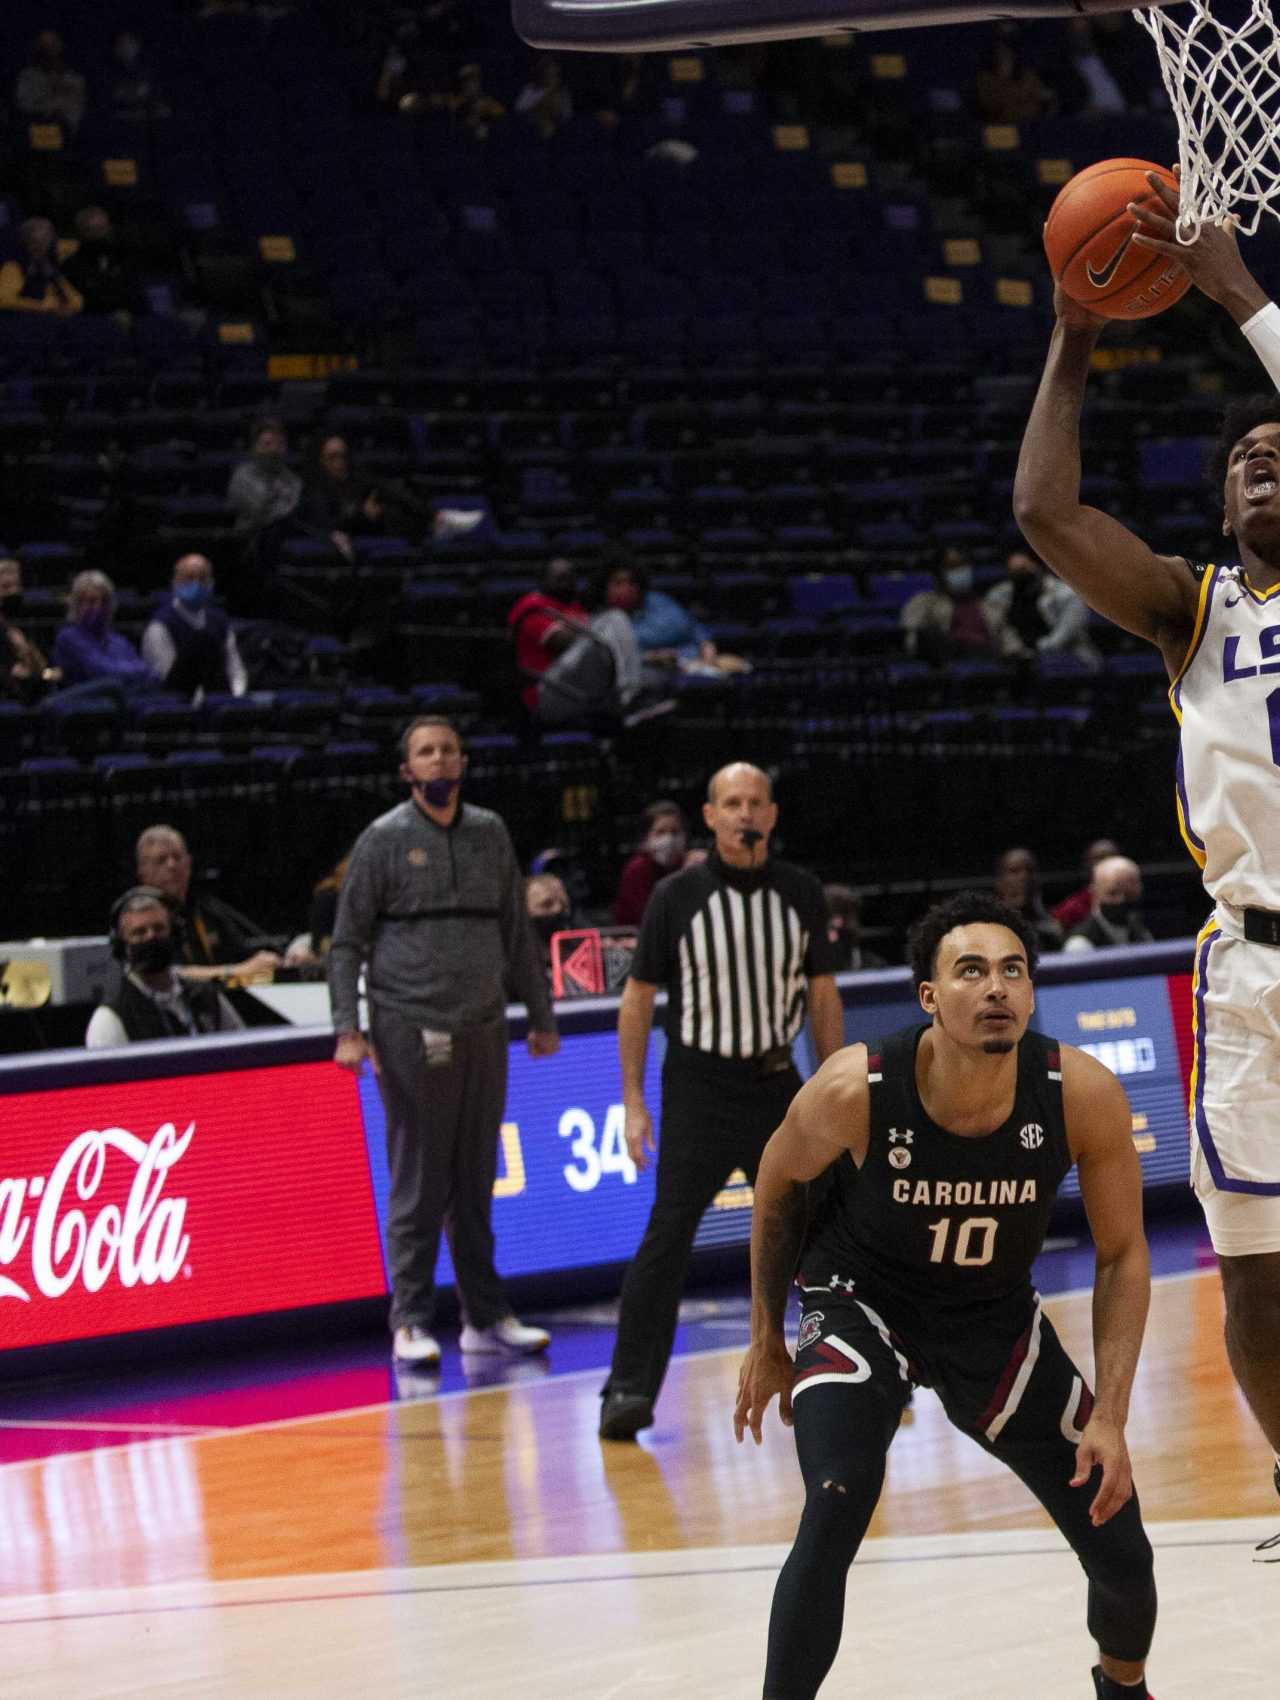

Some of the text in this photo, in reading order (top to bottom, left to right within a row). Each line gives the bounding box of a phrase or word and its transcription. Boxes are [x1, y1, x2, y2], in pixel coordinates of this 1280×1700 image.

[557, 1104, 637, 1192] 34
[1019, 1122, 1044, 1149] SEC
[892, 1179, 1037, 1206] CAROLINA
[928, 1217, 999, 1266] 10
